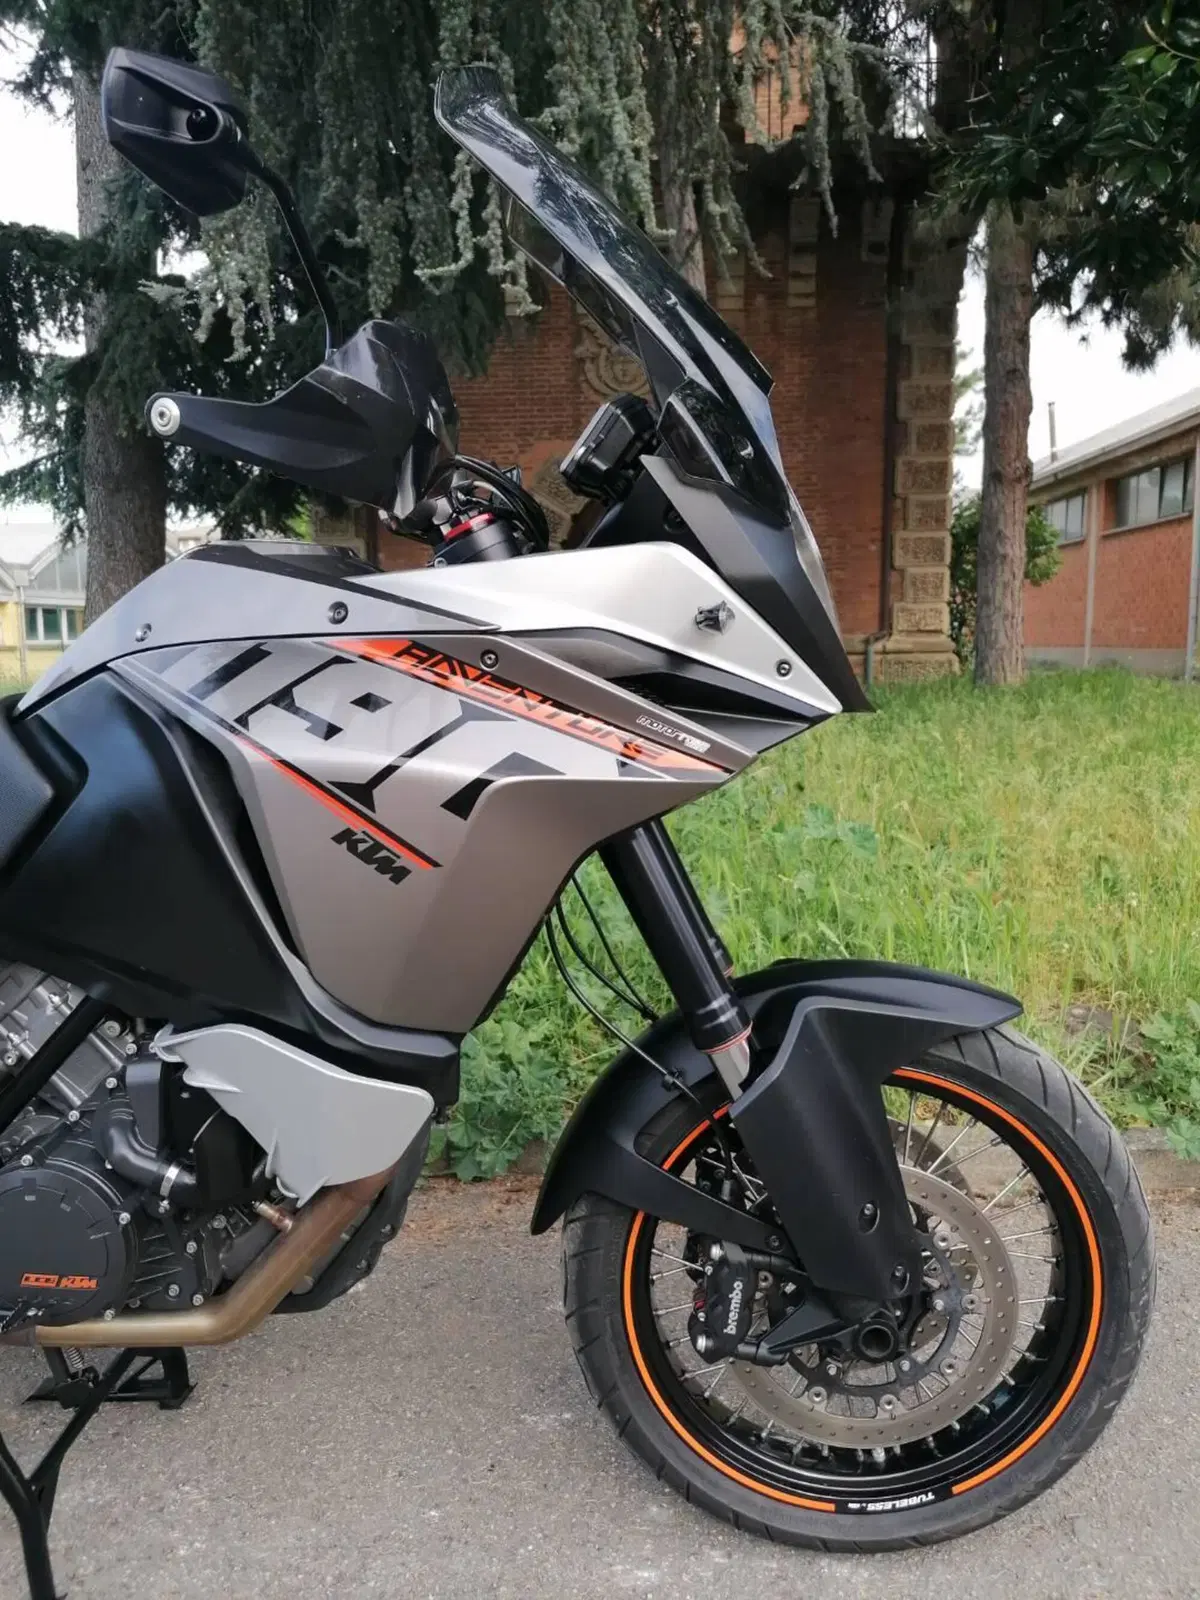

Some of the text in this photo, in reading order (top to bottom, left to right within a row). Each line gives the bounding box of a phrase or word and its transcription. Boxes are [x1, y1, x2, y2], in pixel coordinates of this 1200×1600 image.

[390, 640, 671, 761] ADVENTURE
[331, 826, 411, 886] KTM
[723, 1280, 744, 1335] brembo
[866, 1491, 936, 1511] TUBELESS
